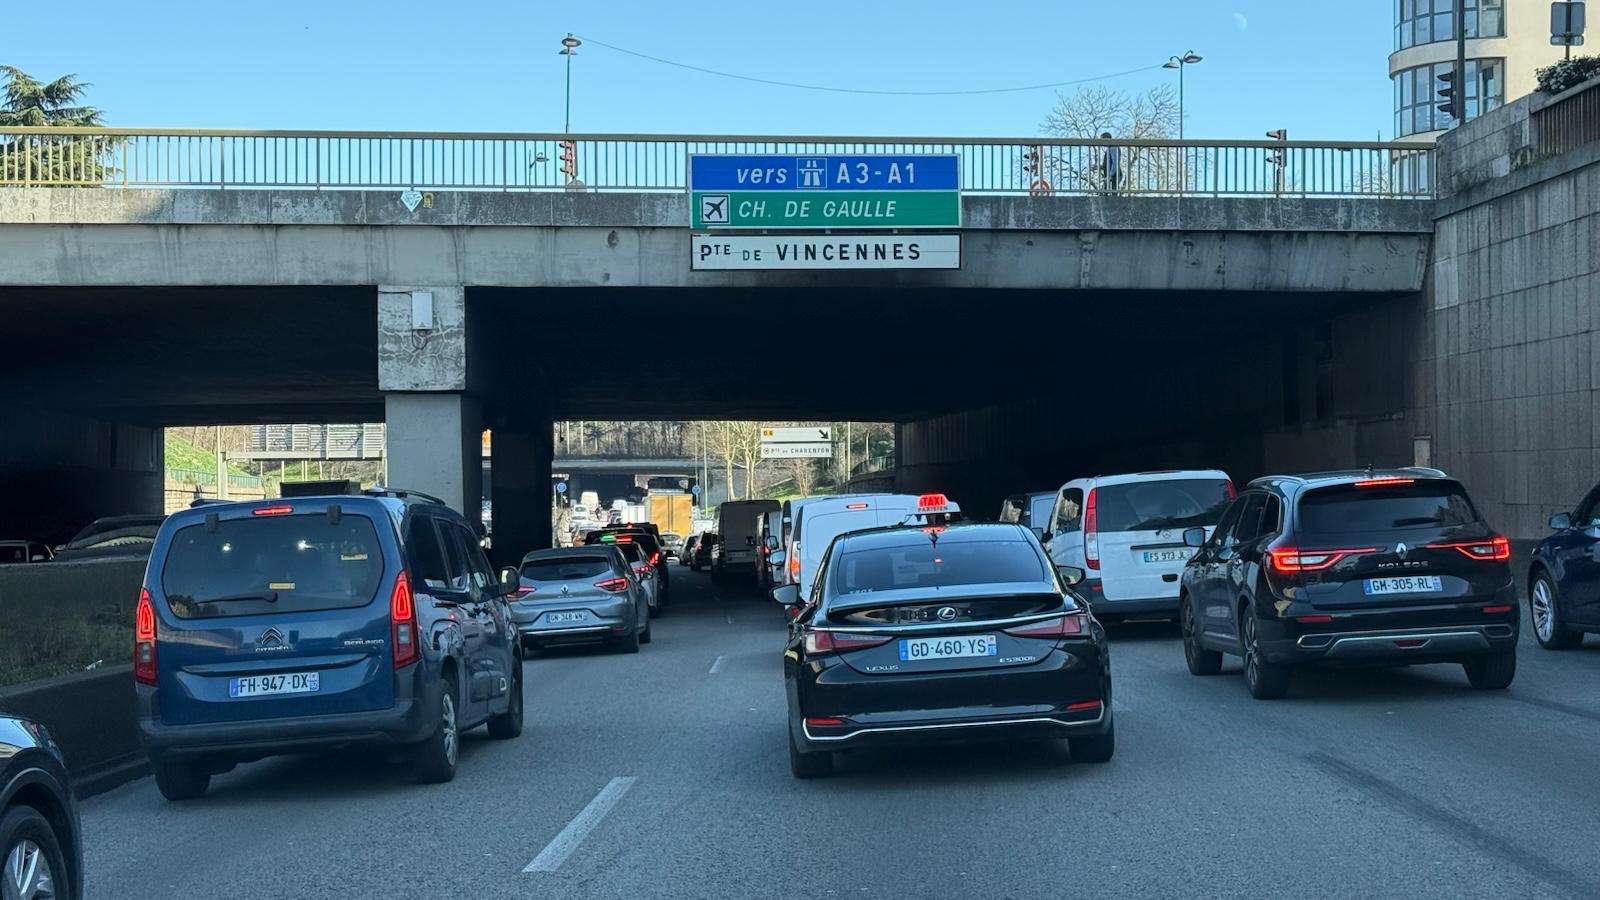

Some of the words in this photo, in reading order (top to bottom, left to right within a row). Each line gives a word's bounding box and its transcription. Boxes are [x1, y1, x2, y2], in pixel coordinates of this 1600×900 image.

[737, 167, 787, 184] vers
[738, 200, 772, 218] CH.
[784, 200, 811, 218] DE
[823, 200, 897, 218] GAULLE
[742, 250, 762, 261] DE
[776, 243, 920, 261] VINCENNES
[920, 495, 944, 507] TAXI
[1372, 577, 1433, 592] GH-305-RL
[911, 639, 987, 658] GD-460-YS
[239, 673, 309, 694] FH-947-DX
